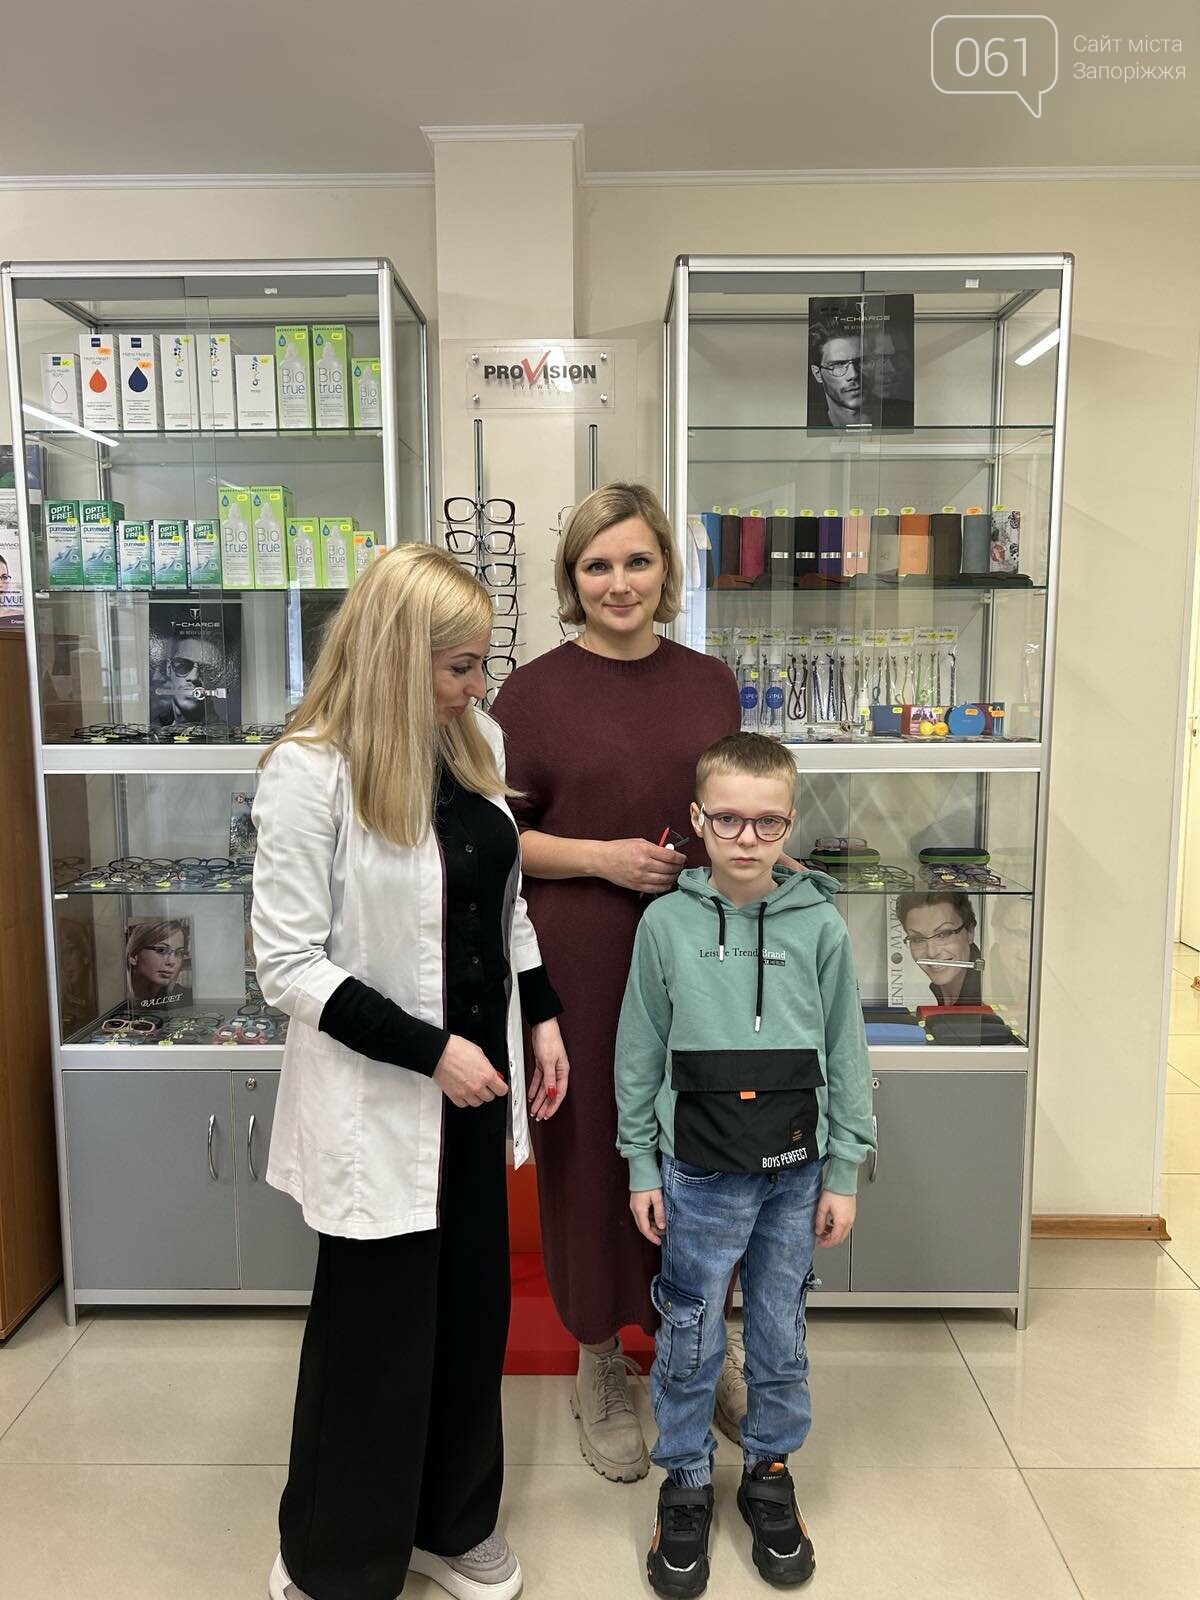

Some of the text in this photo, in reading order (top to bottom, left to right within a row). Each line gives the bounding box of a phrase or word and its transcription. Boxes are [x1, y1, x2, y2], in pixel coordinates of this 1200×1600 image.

[484, 350, 597, 385] PROVISION
[282, 368, 305, 384] Bio
[319, 367, 343, 383] Bio
[282, 384, 306, 395] true
[319, 383, 343, 394] true
[361, 386, 377, 398] Bio
[51, 505, 73, 514] OPTI-
[85, 505, 106, 514] OPTI-
[224, 527, 248, 542] Bio
[257, 527, 280, 542] Bio
[225, 543, 248, 552] true
[257, 543, 280, 552] true
[295, 545, 312, 555] Bio
[328, 545, 345, 555] Bio
[732, 947, 758, 957] Trend
[763, 948, 786, 960] Brand
[890, 969, 904, 1006] ENNI
[140, 992, 184, 1008] BALLET
[762, 1147, 808, 1168] BOYS PERFECT
